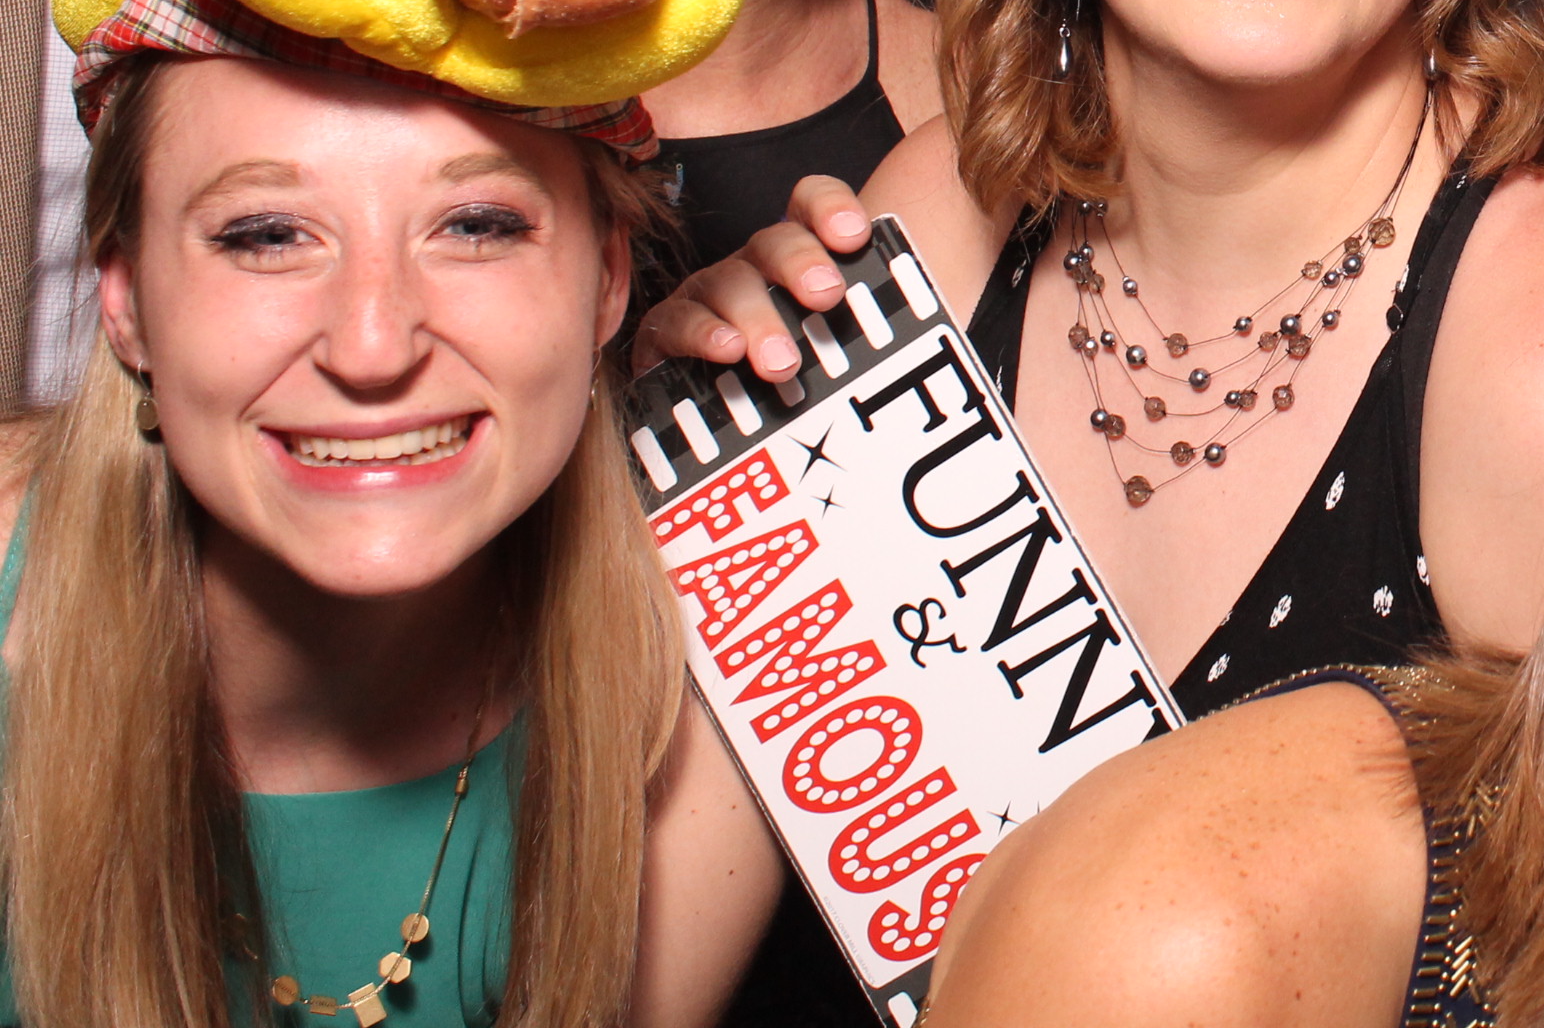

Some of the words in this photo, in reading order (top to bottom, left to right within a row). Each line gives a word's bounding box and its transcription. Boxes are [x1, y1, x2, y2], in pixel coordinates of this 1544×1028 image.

[649, 446, 989, 962] FAMOUS
[849, 334, 1173, 754] FUNN
[893, 598, 967, 669] &
